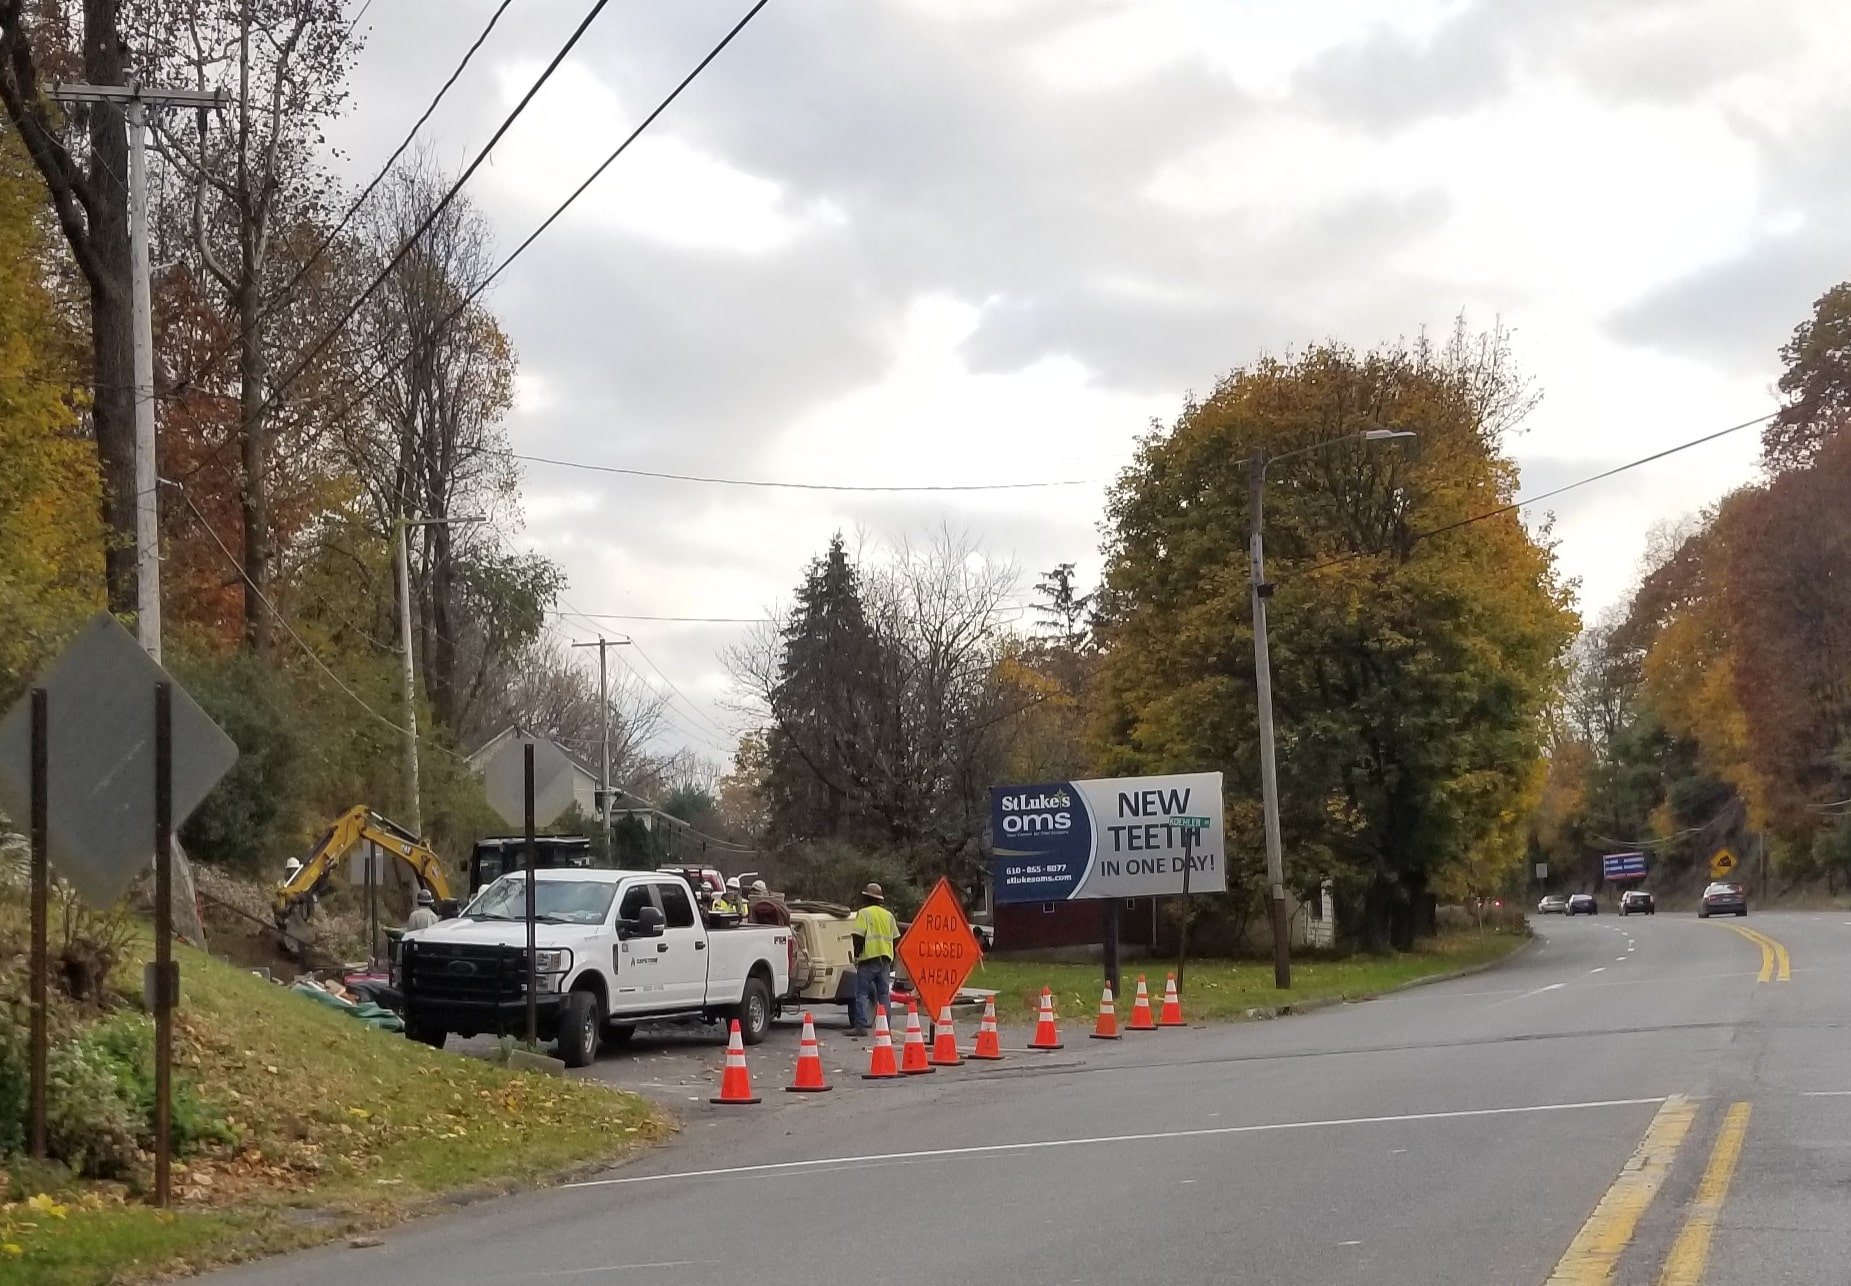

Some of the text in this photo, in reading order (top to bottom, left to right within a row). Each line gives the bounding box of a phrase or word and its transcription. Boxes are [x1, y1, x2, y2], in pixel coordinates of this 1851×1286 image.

[1118, 787, 1191, 818] NEW
[1002, 812, 1072, 832] oms
[1107, 823, 1201, 852] TEETH
[1101, 854, 1215, 877] IN ONE DAY!
[926, 914, 958, 931] ROAD
[918, 941, 963, 959] CLOSED
[918, 968, 958, 985] AHEAD
